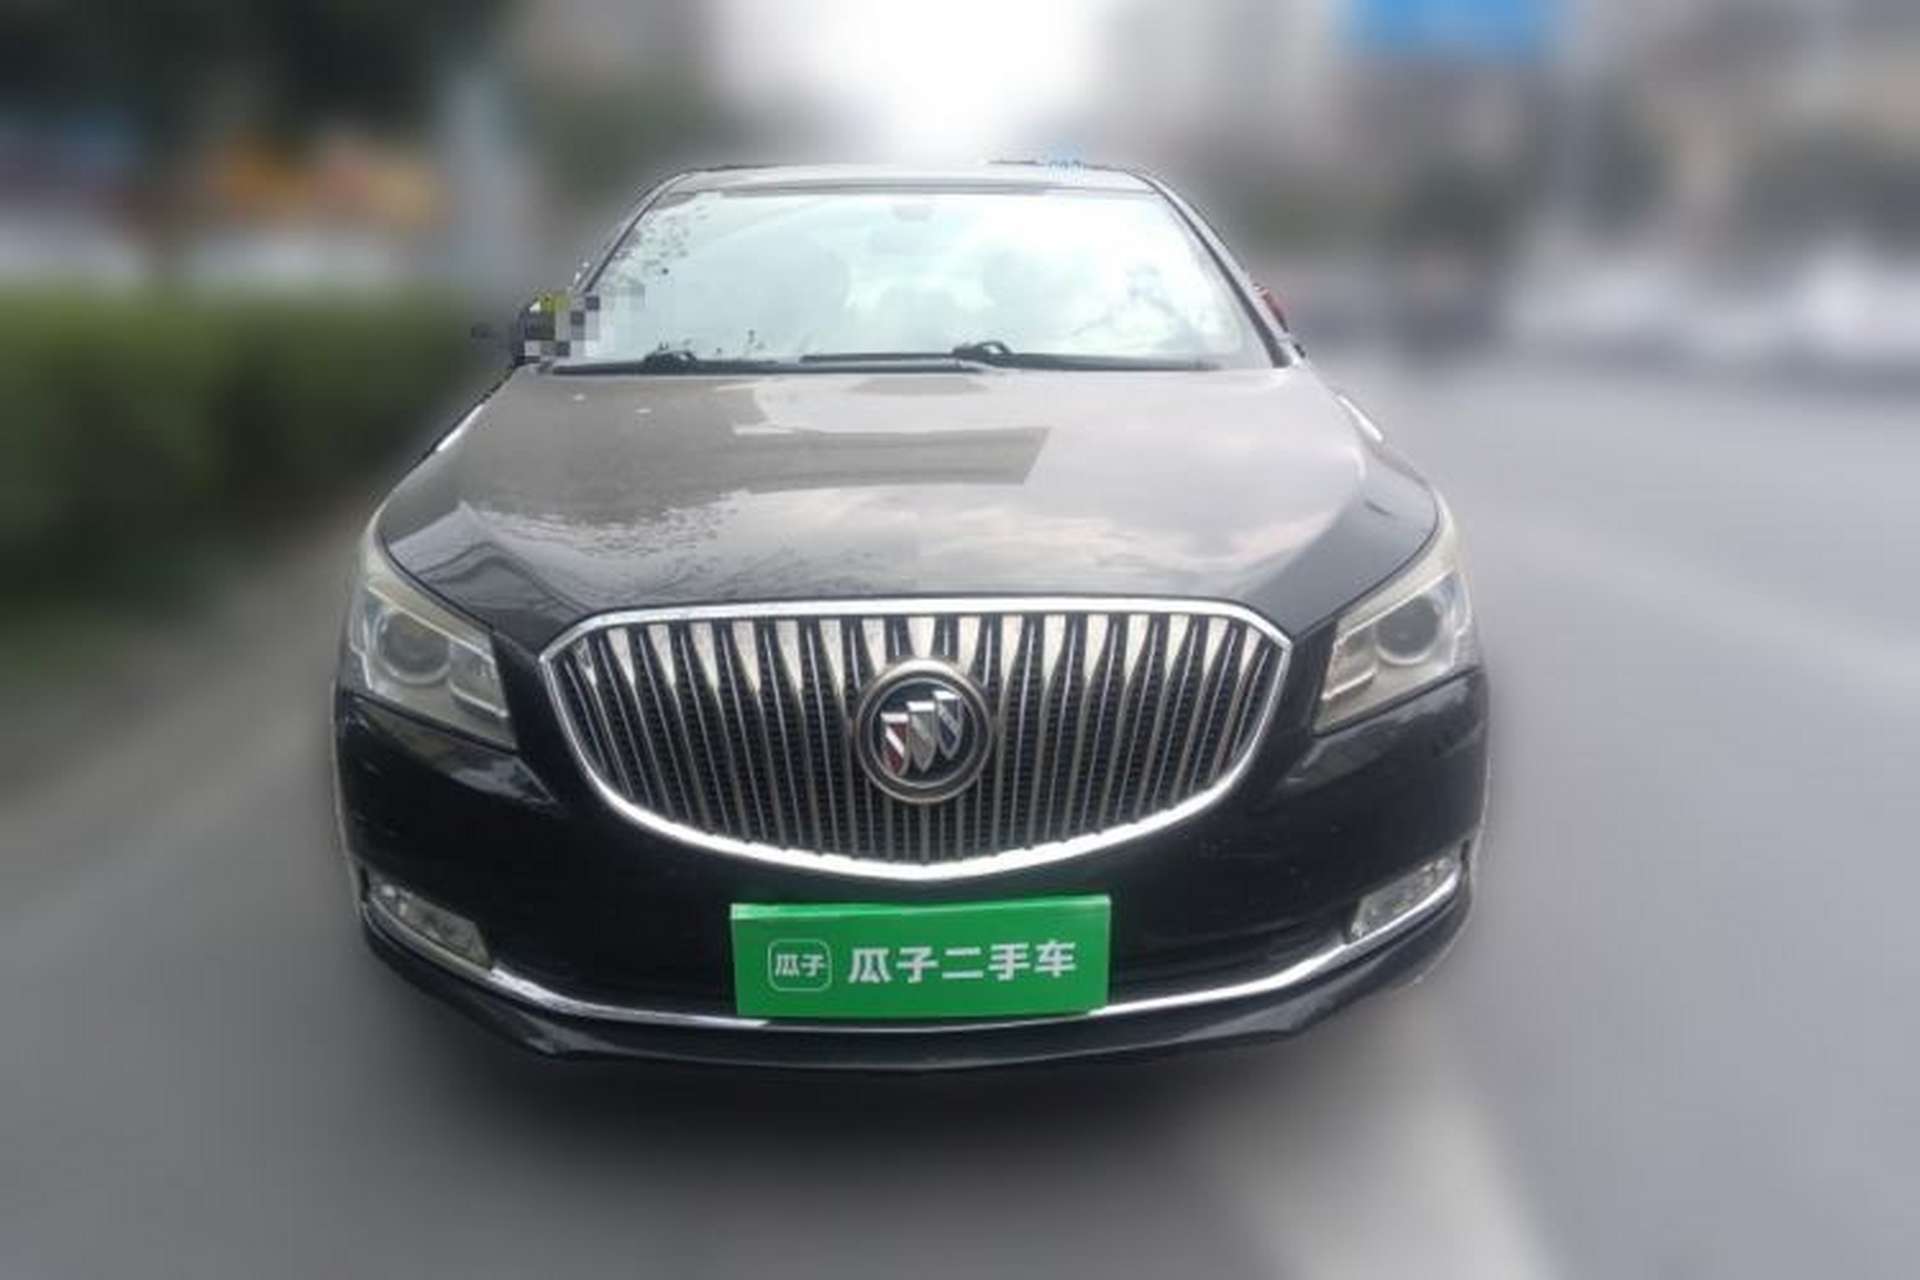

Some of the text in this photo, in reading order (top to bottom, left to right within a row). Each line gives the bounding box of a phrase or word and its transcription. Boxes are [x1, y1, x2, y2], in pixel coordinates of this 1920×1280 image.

[774, 953, 826, 977] 瓜子
[848, 939, 1077, 984] 瓜子二手车
